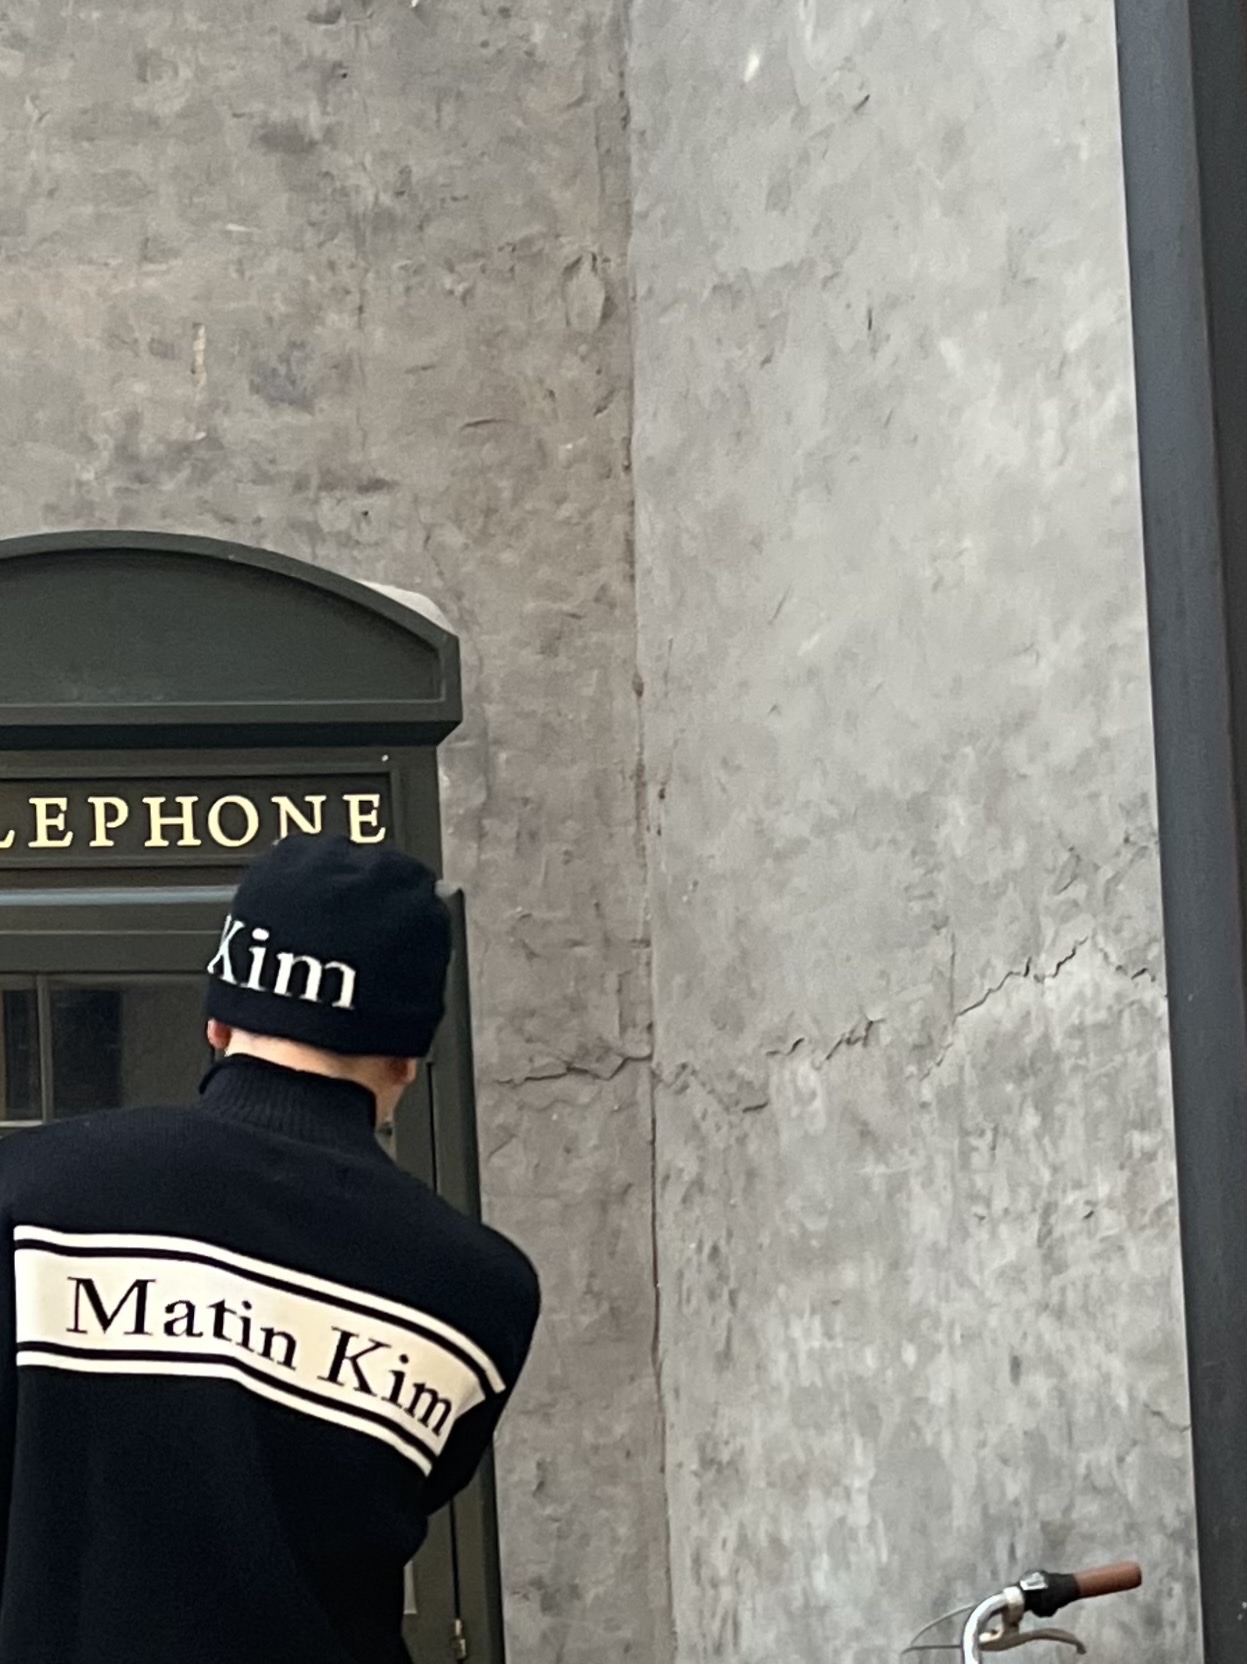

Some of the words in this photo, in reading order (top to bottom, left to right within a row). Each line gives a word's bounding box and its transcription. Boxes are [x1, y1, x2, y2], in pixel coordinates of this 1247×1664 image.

[207, 914, 356, 1010] Kim
[65, 1276, 298, 1371] Matin
[317, 1325, 454, 1438] Kim
